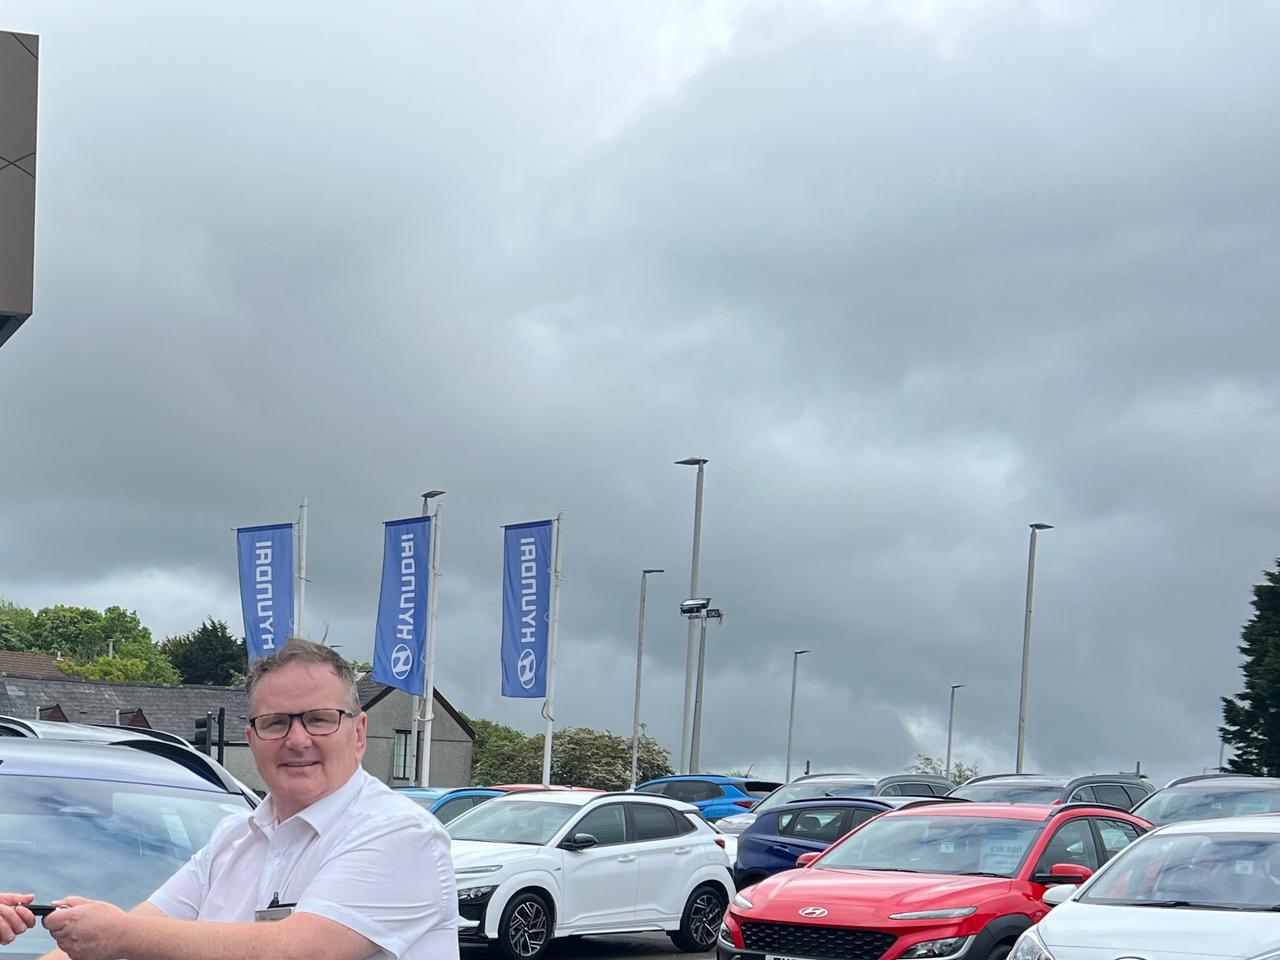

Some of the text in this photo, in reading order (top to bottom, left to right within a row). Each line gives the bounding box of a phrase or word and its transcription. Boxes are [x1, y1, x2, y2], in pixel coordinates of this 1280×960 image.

[255, 541, 275, 650] HYUNDAI
[396, 533, 416, 640] HYUNDAI
[520, 537, 537, 643] HYUNDAI
